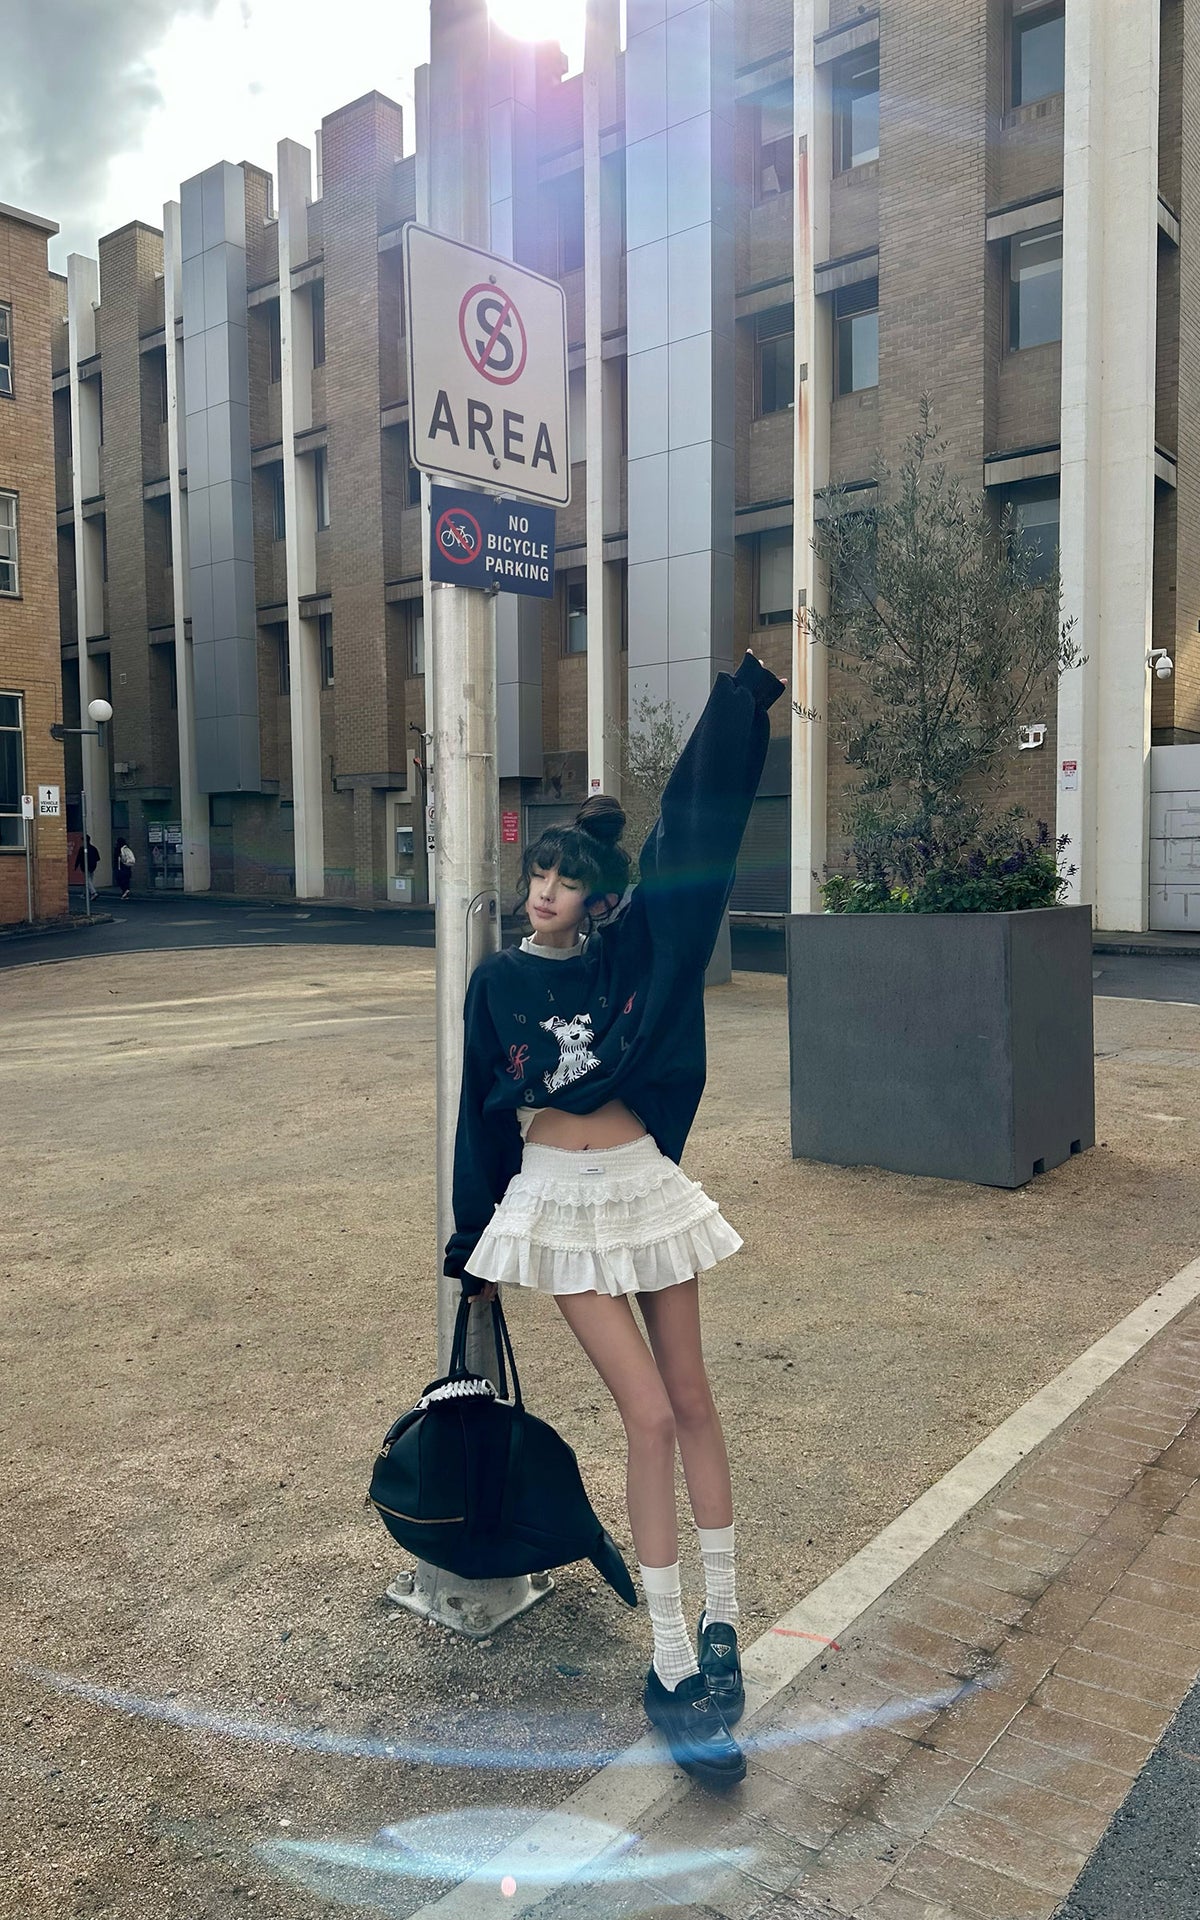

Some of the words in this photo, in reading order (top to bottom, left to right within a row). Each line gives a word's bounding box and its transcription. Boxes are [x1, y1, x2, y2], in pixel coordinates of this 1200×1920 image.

[427, 390, 558, 475] AREA
[508, 515, 529, 534] NO
[487, 533, 549, 561] BICYCLE
[485, 556, 549, 582] PARKING
[41, 805, 58, 813] EXIT
[598, 996, 609, 1008] 2
[512, 1013, 526, 1024] 10
[524, 1089, 535, 1103] 8
